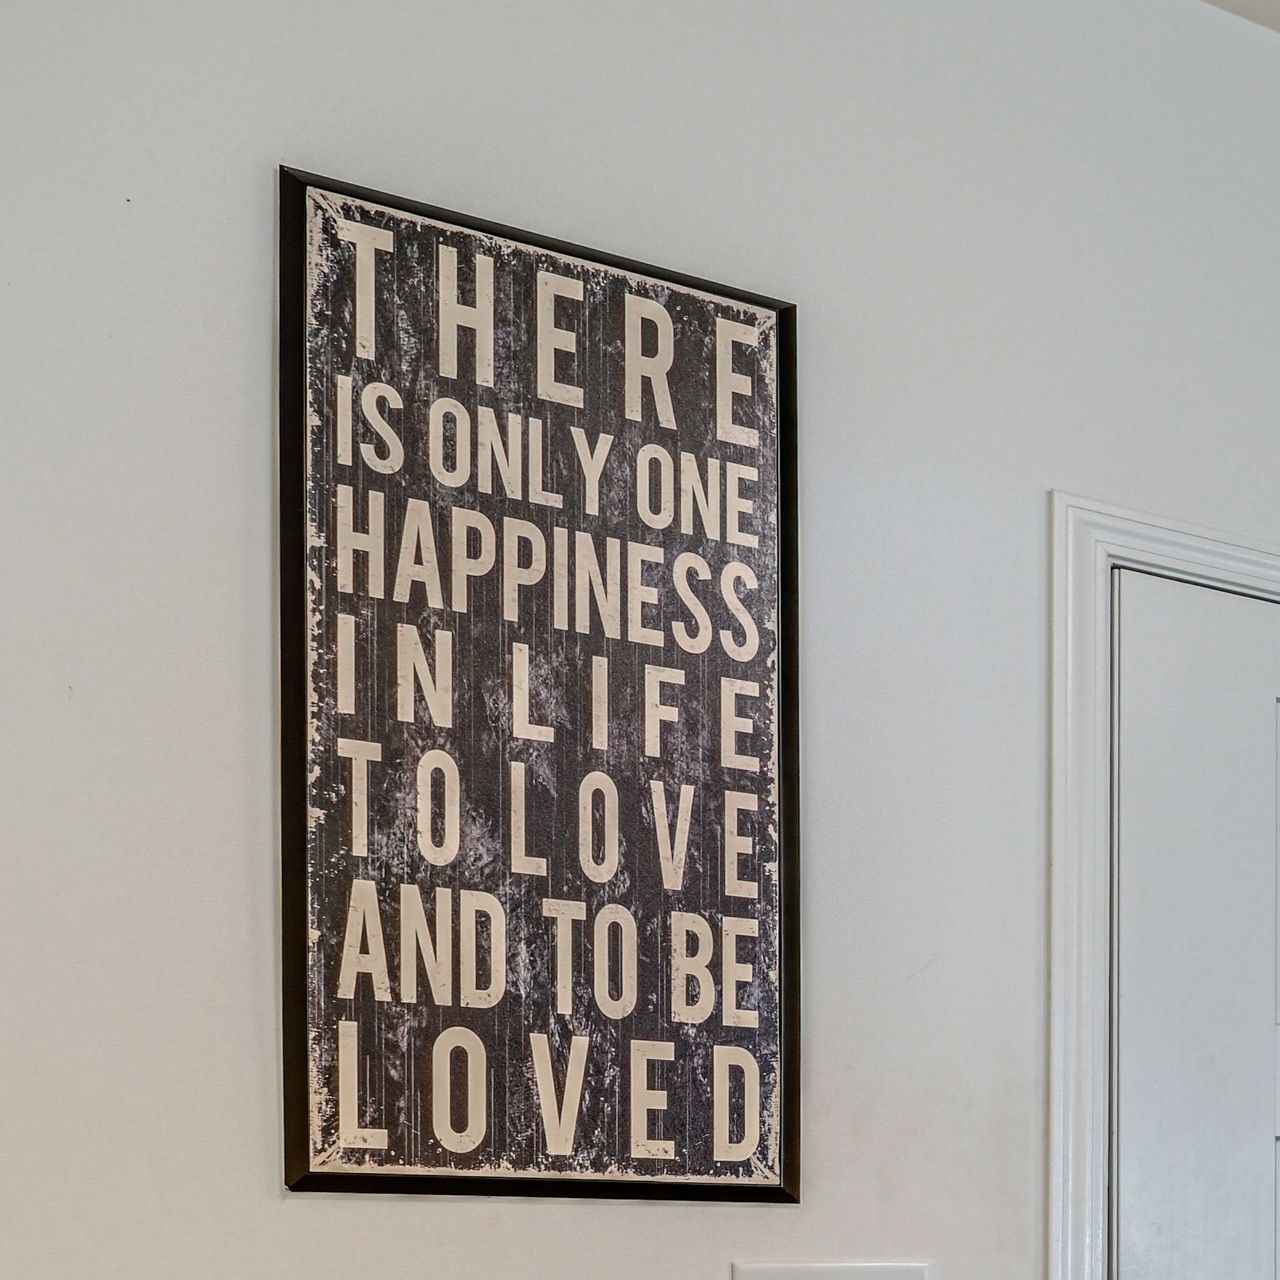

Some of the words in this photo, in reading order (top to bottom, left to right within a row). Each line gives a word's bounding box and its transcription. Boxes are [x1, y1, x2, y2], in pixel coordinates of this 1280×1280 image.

[335, 219, 760, 448] THERE
[336, 374, 404, 475] IS
[429, 397, 614, 516] ONLY
[636, 444, 759, 549] ONE
[336, 483, 760, 663] HAPPINESS
[336, 613, 453, 728] IN
[512, 642, 760, 772] LIFE
[336, 738, 460, 866] TO
[510, 761, 759, 898] LOVE
[336, 879, 505, 1009] AND
[542, 897, 638, 1020] TO
[670, 911, 759, 1028] BE
[337, 1020, 760, 1162] LOVED
